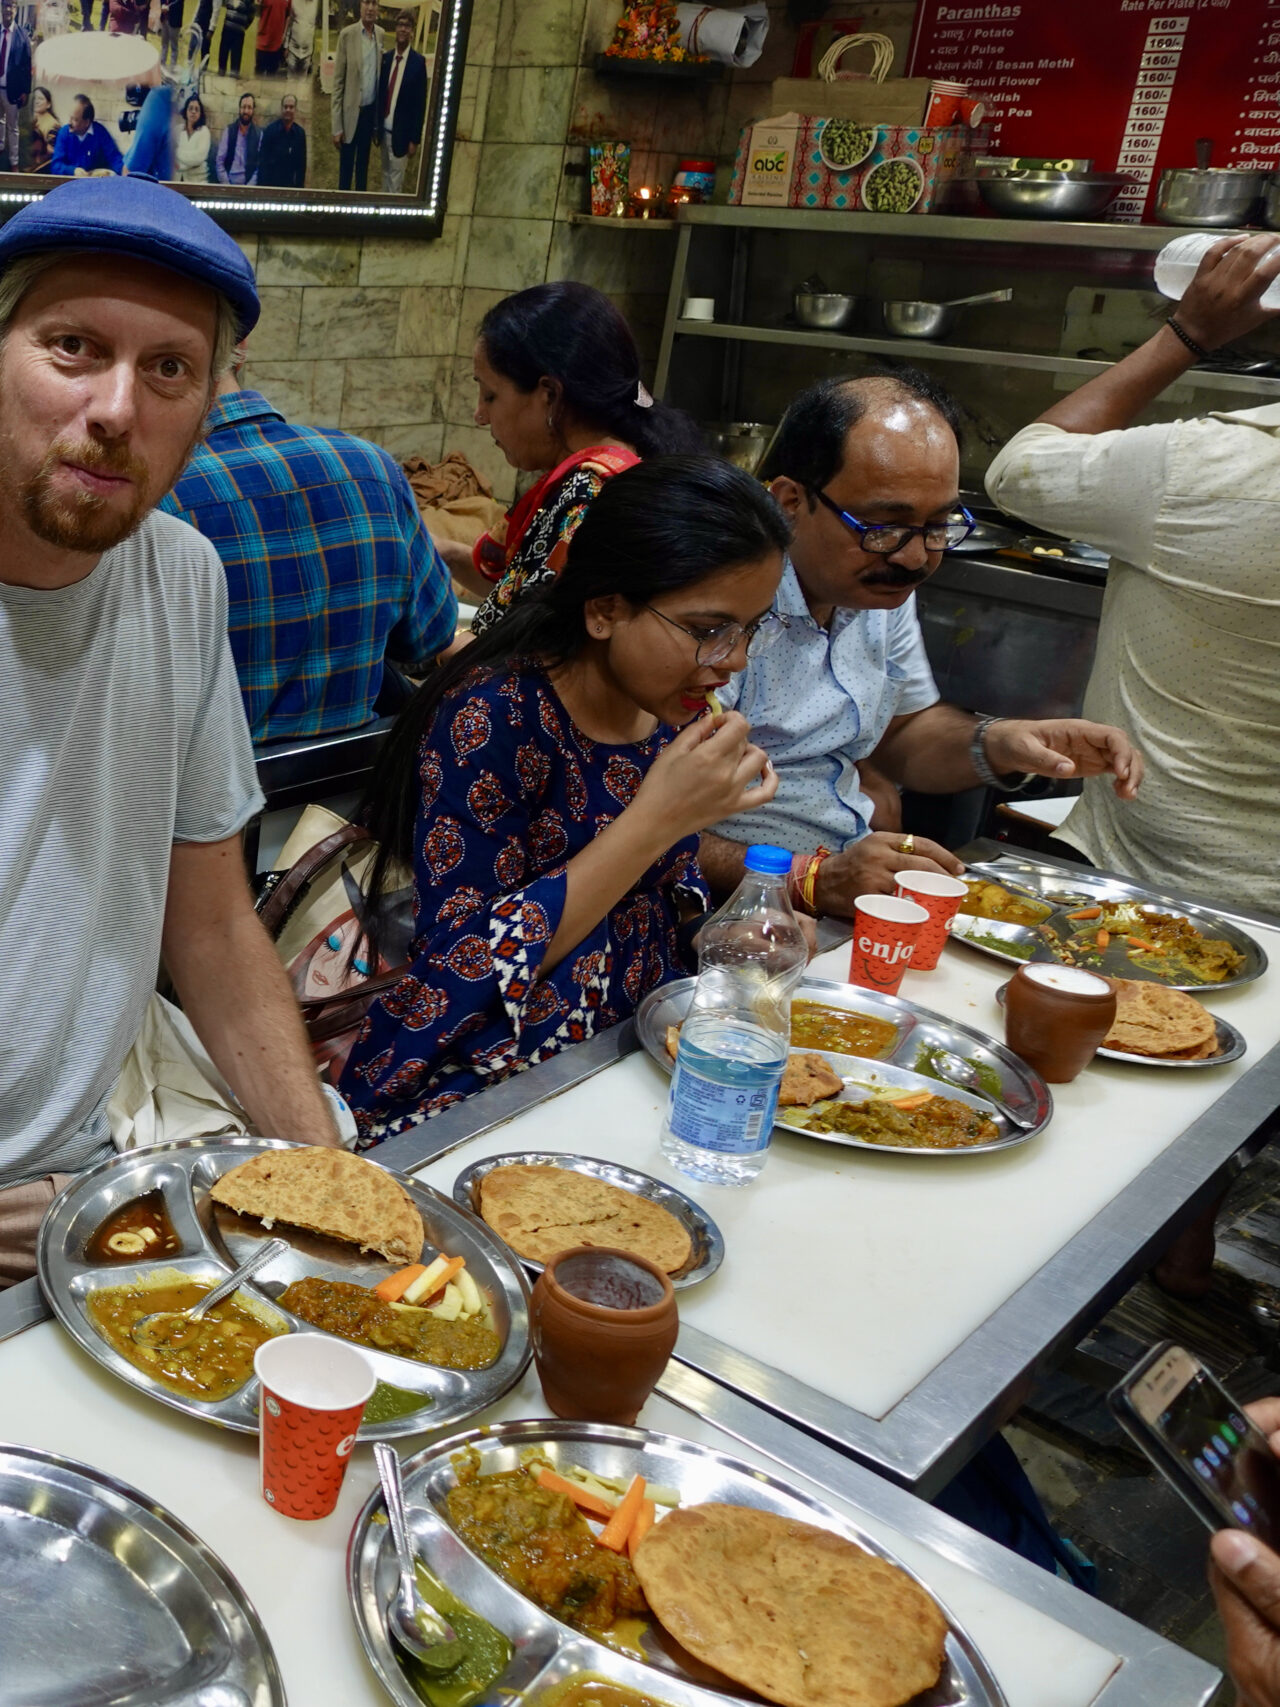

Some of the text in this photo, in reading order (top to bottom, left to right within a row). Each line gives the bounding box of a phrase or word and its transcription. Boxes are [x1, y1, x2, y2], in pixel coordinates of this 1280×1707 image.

[1120, 0, 1145, 11] Rate
[1147, 0, 1166, 10] Per
[1167, 0, 1195, 9] Plate
[936, 4, 1021, 20] Paranthas
[940, 29, 965, 41] आलू
[974, 28, 1014, 38] Potato
[1150, 38, 1181, 48] 160/-
[971, 44, 1005, 54] Pulse
[995, 60, 1034, 70] Besan
[1037, 57, 1075, 69] Methi
[1145, 55, 1176, 65] 160/-
[965, 77, 996, 87] Cauli
[999, 76, 1042, 86] Flower
[1141, 73, 1172, 83] 160/-
[1137, 90, 1168, 100] 160/-
[1007, 107, 1033, 117] Pea
[1134, 106, 1165, 116] 160/-
[1130, 122, 1160, 132] 160/-
[1126, 138, 1156, 148] 160/-
[1122, 154, 1152, 163] 160/-
[754, 158, 785, 172] abc
[1121, 186, 1144, 195] 80/-
[1112, 202, 1141, 212] 180/-
[858, 936, 916, 964] enjo
